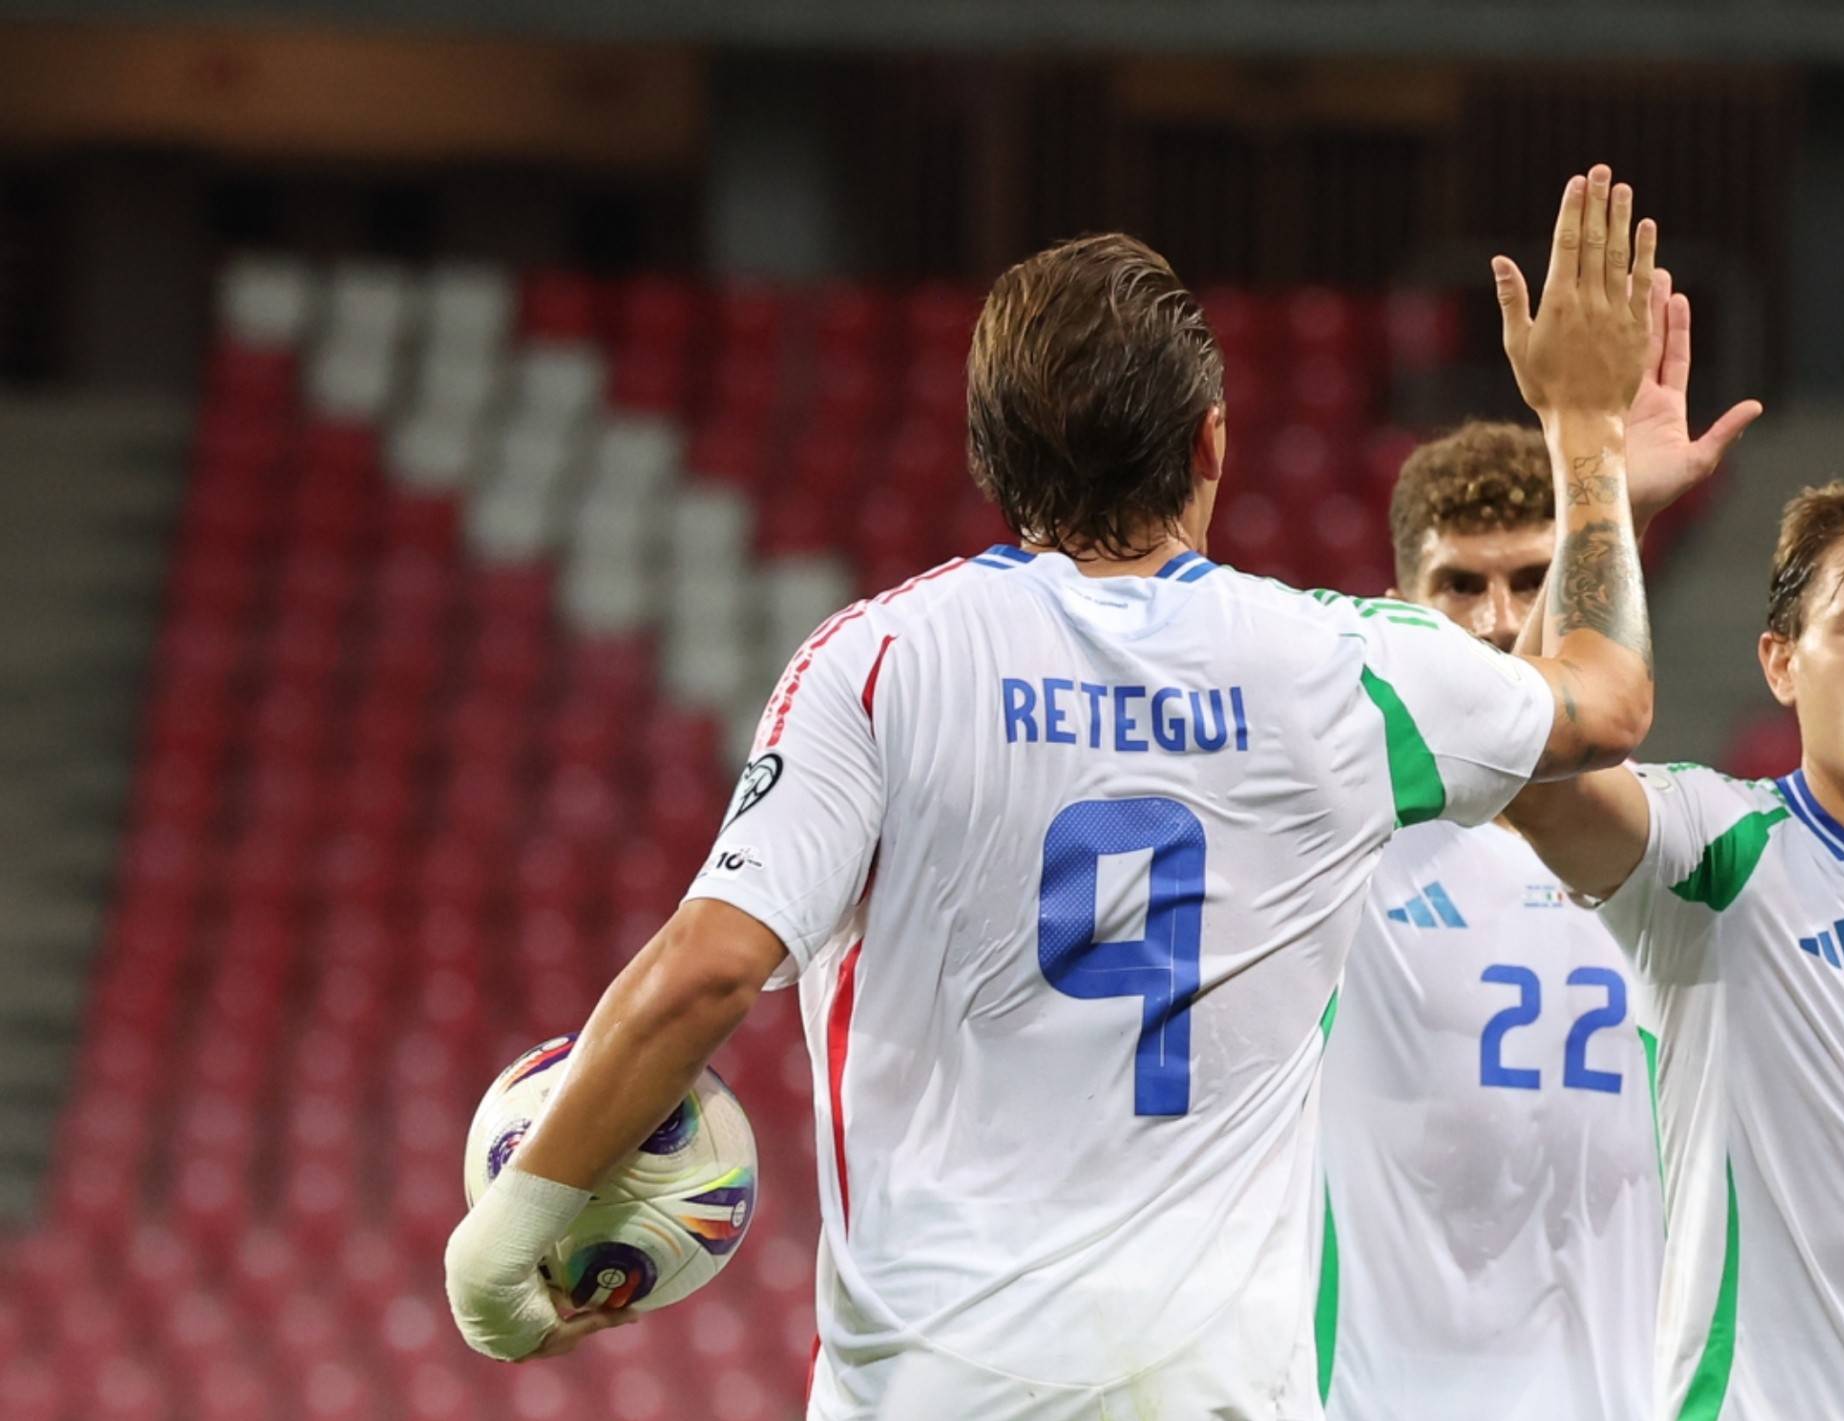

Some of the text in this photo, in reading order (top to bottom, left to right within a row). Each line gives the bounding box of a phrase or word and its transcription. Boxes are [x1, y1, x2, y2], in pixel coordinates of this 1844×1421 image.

[1002, 677, 1248, 752] RETEGUI
[1037, 796, 1207, 1117] 9
[1479, 963, 1628, 1094] 22
